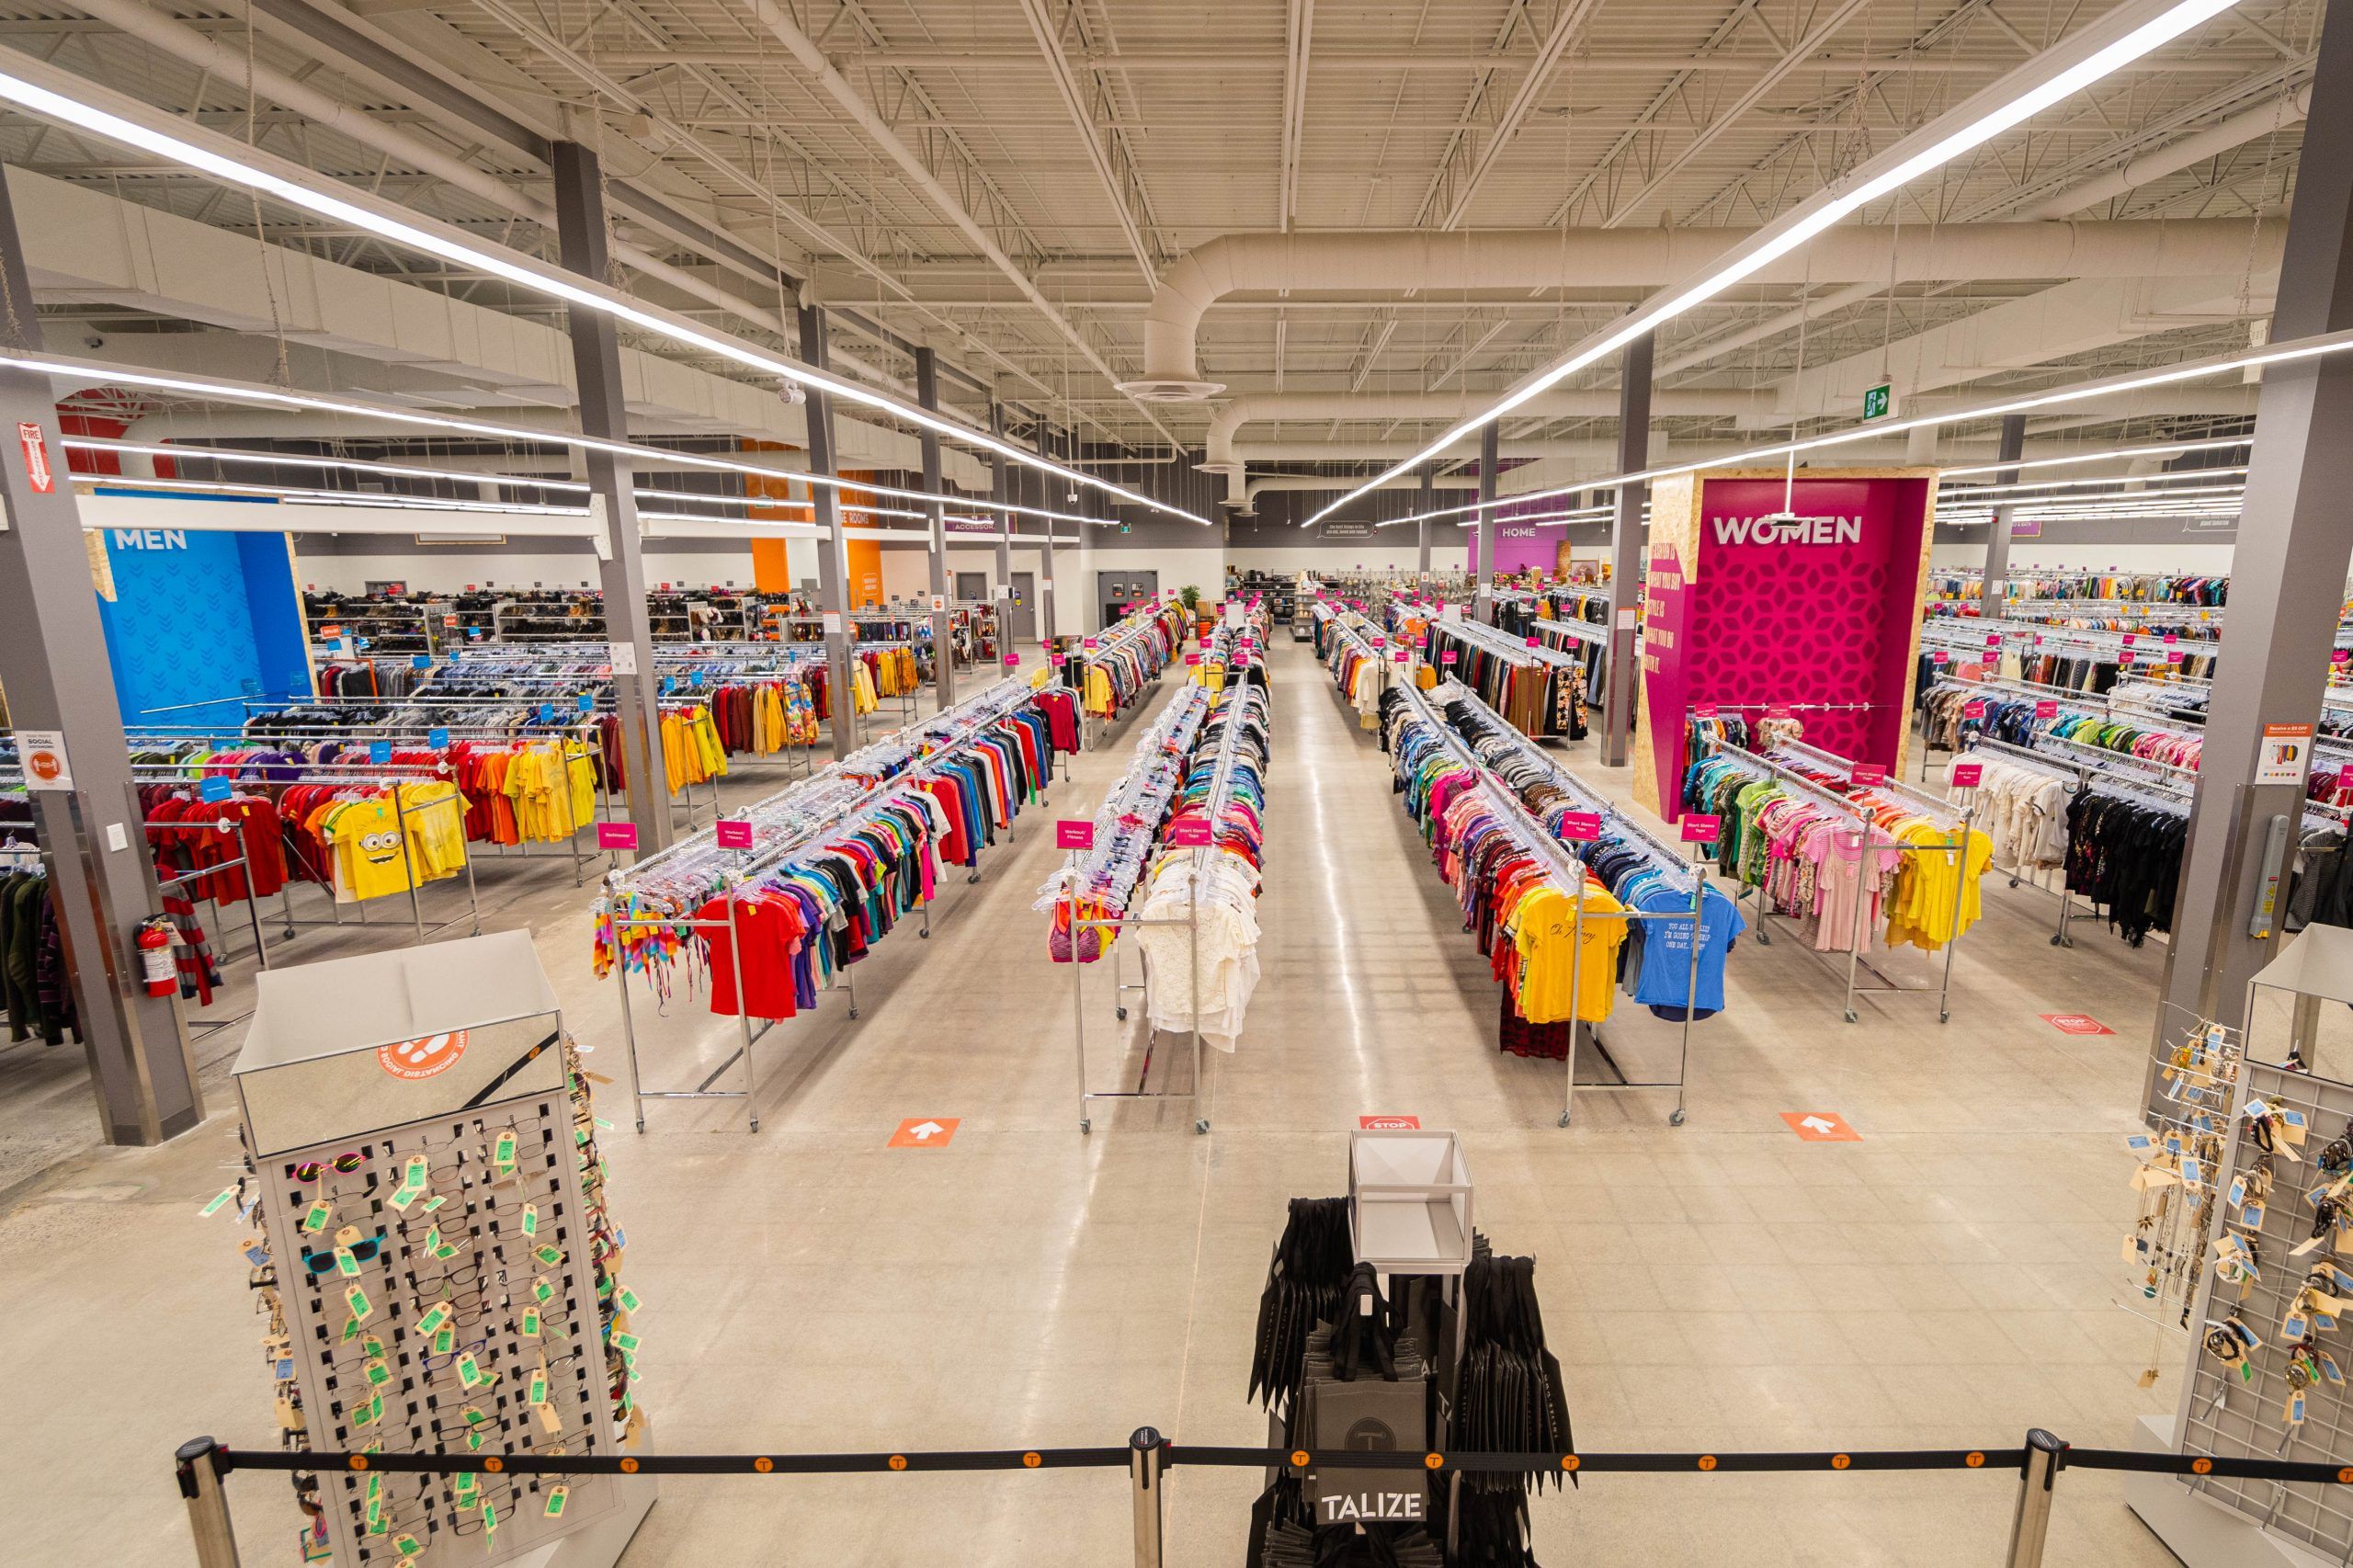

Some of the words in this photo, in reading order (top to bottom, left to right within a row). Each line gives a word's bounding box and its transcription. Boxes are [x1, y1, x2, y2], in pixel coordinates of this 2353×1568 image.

[23, 429, 40, 439] FIRE
[848, 512, 869, 524] ROOMS
[1502, 528, 1536, 537] HOME
[1713, 517, 1862, 545] WOMEN
[114, 529, 188, 550] MEN
[1321, 1492, 1421, 1519] TALIZE
